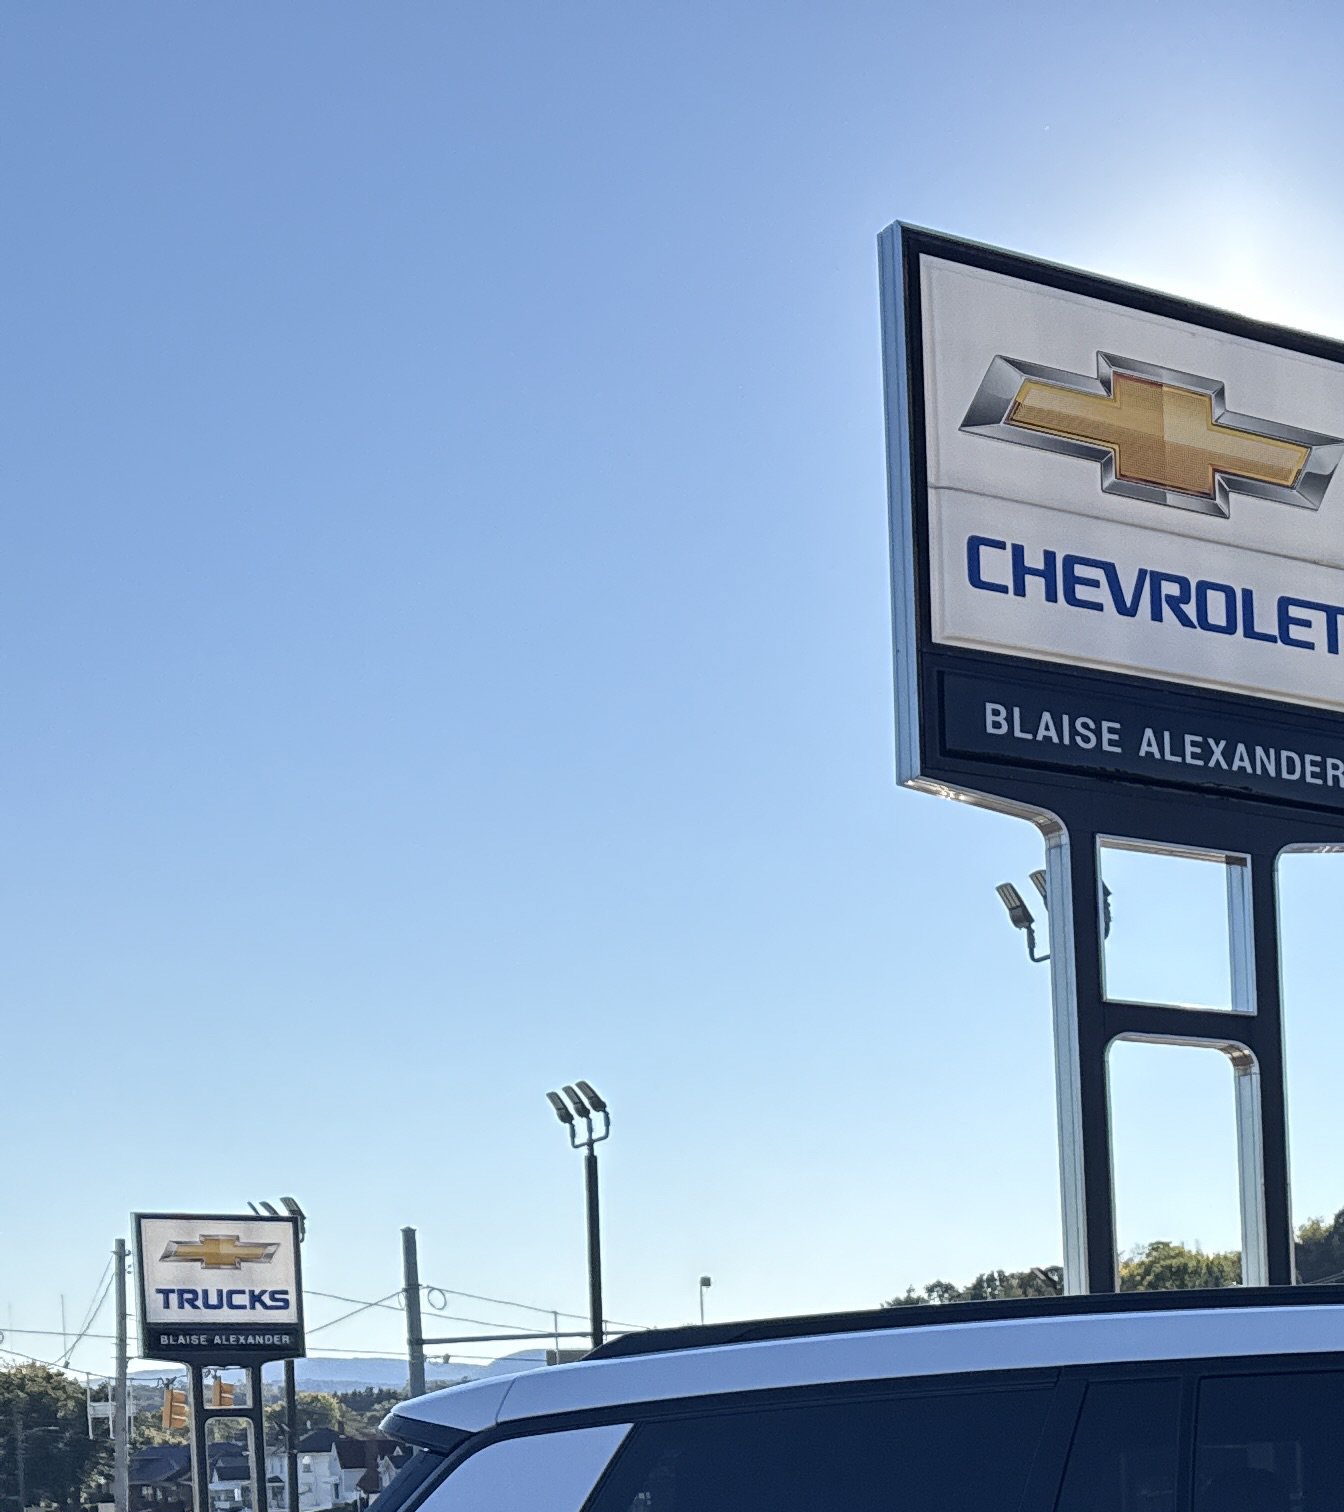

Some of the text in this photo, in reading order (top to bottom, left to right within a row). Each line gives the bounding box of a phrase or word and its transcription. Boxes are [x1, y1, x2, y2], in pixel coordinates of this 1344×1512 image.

[985, 702, 1122, 753] BLAISE
[155, 1288, 290, 1310] TRUCKS
[160, 1335, 290, 1345] BLAISE ALEXANDER
